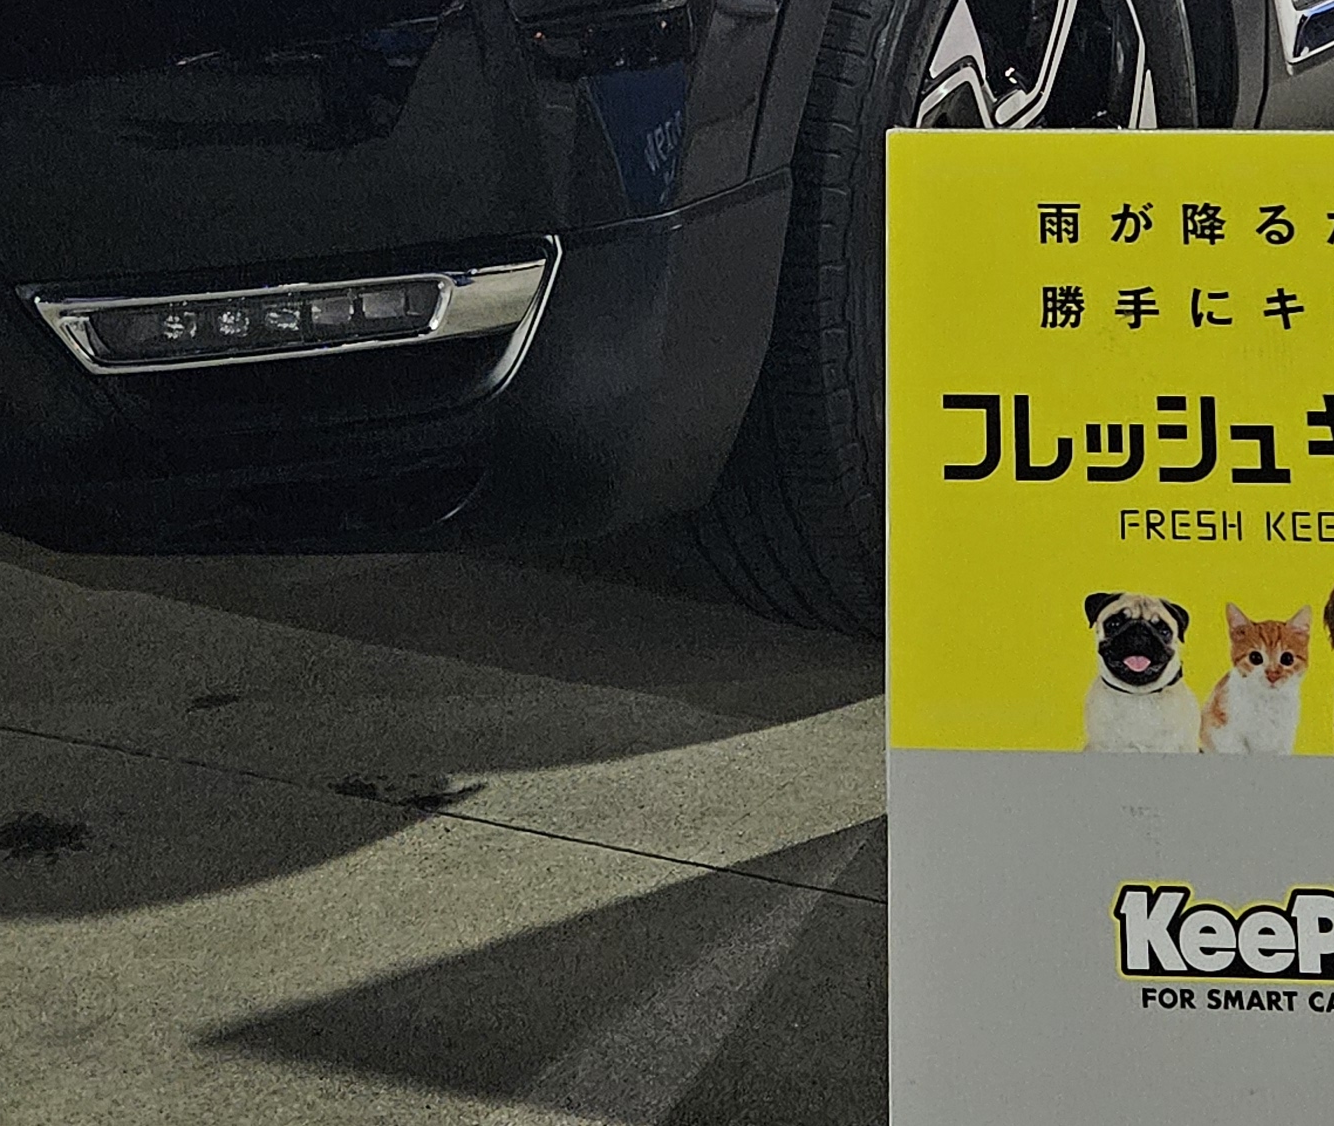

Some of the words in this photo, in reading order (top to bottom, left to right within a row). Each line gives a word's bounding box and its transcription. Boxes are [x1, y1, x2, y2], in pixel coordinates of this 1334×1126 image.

[1120, 509, 1243, 542] FRESH
[1141, 987, 1197, 1010] FOR
[1206, 990, 1298, 1012] SMART
